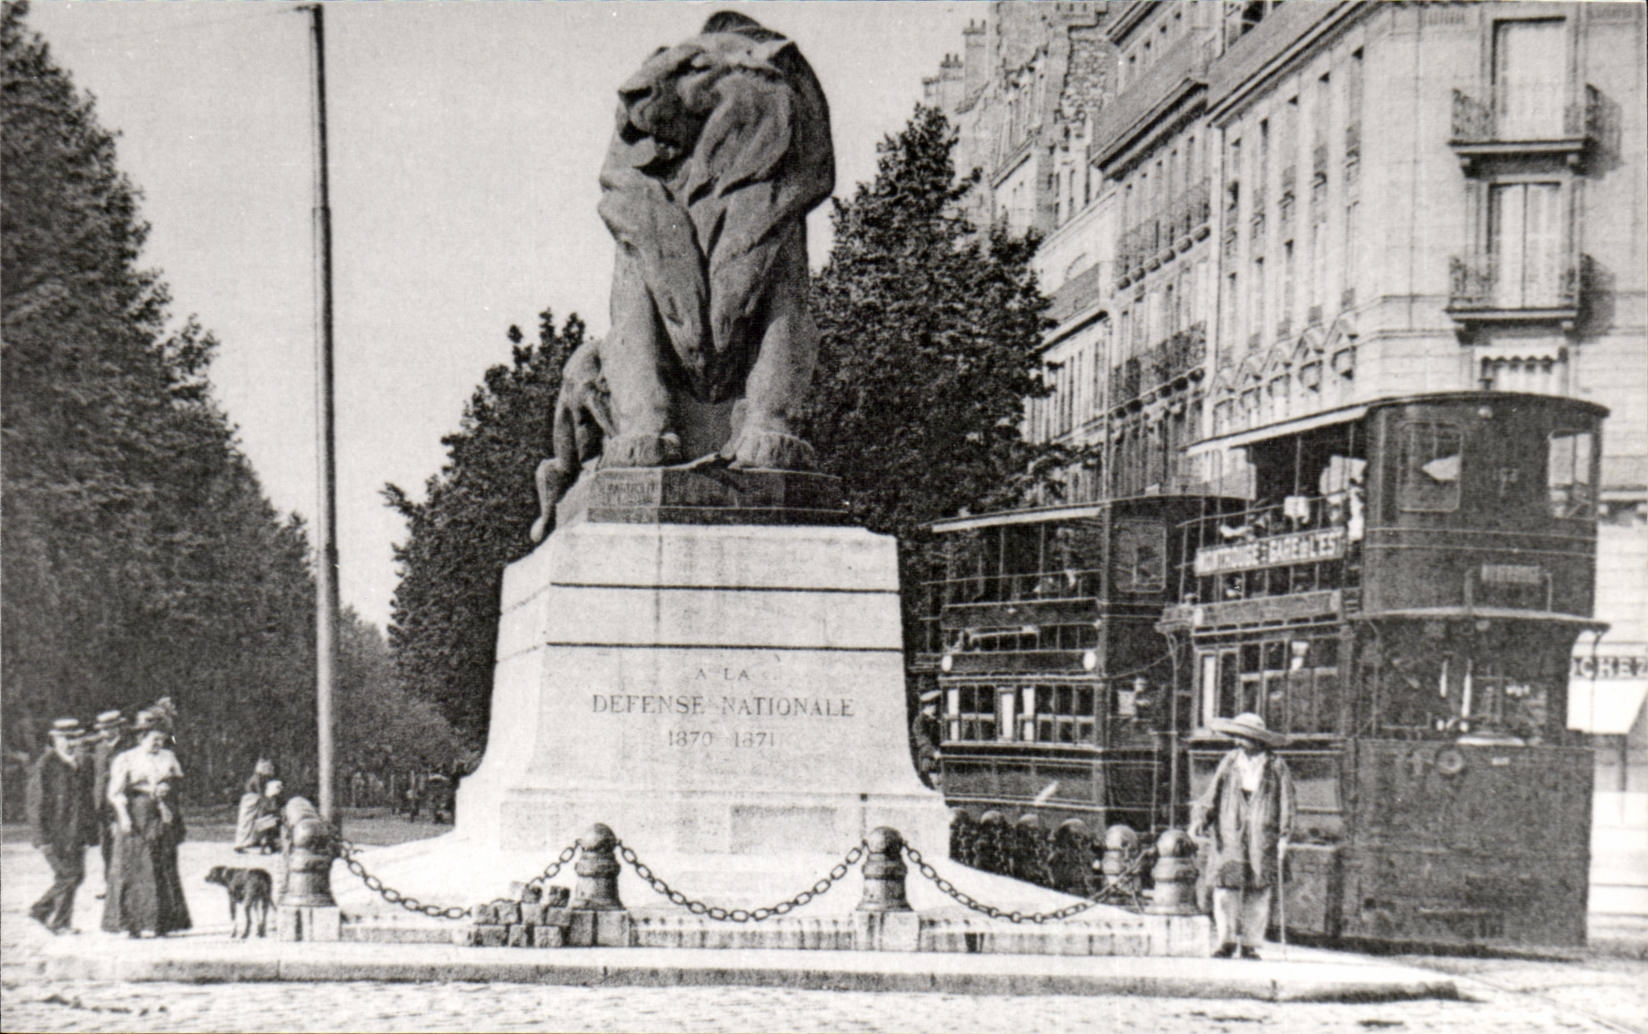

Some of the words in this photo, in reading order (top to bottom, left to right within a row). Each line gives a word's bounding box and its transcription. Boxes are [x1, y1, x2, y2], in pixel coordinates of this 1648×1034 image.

[695, 667, 706, 680] A
[724, 667, 750, 680] LA
[592, 694, 705, 715] DEFENSE
[722, 696, 855, 717] NATIONALE
[669, 730, 713, 747] 1870
[735, 732, 775, 748] 1871
